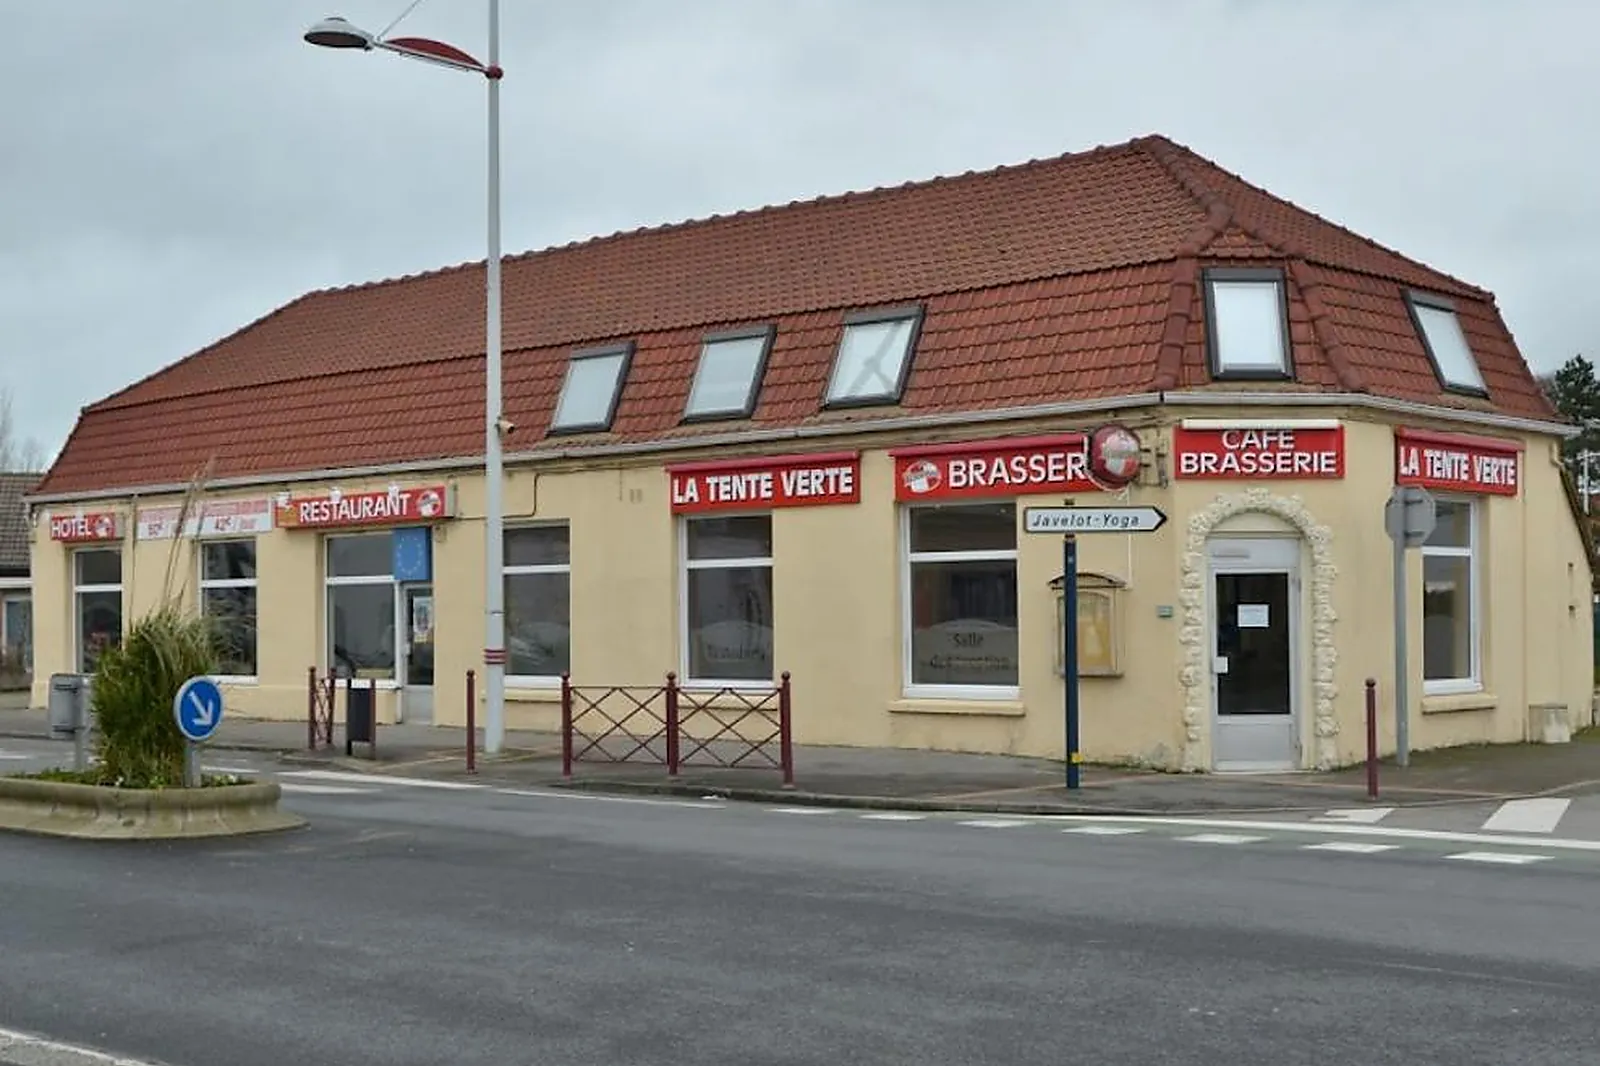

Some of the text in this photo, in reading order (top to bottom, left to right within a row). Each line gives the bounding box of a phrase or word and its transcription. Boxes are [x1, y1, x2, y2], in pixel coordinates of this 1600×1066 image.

[949, 452, 1088, 488] BRASSER
[1180, 452, 1337, 474] BRASSERIE
[1400, 446, 1515, 485] LA TENTE VERTE
[673, 466, 853, 504] LA TENTE VERTE
[300, 493, 412, 523] RESTAURANT
[1032, 513, 1140, 528] Javelot-Yoga
[52, 517, 92, 537] HOTEL
